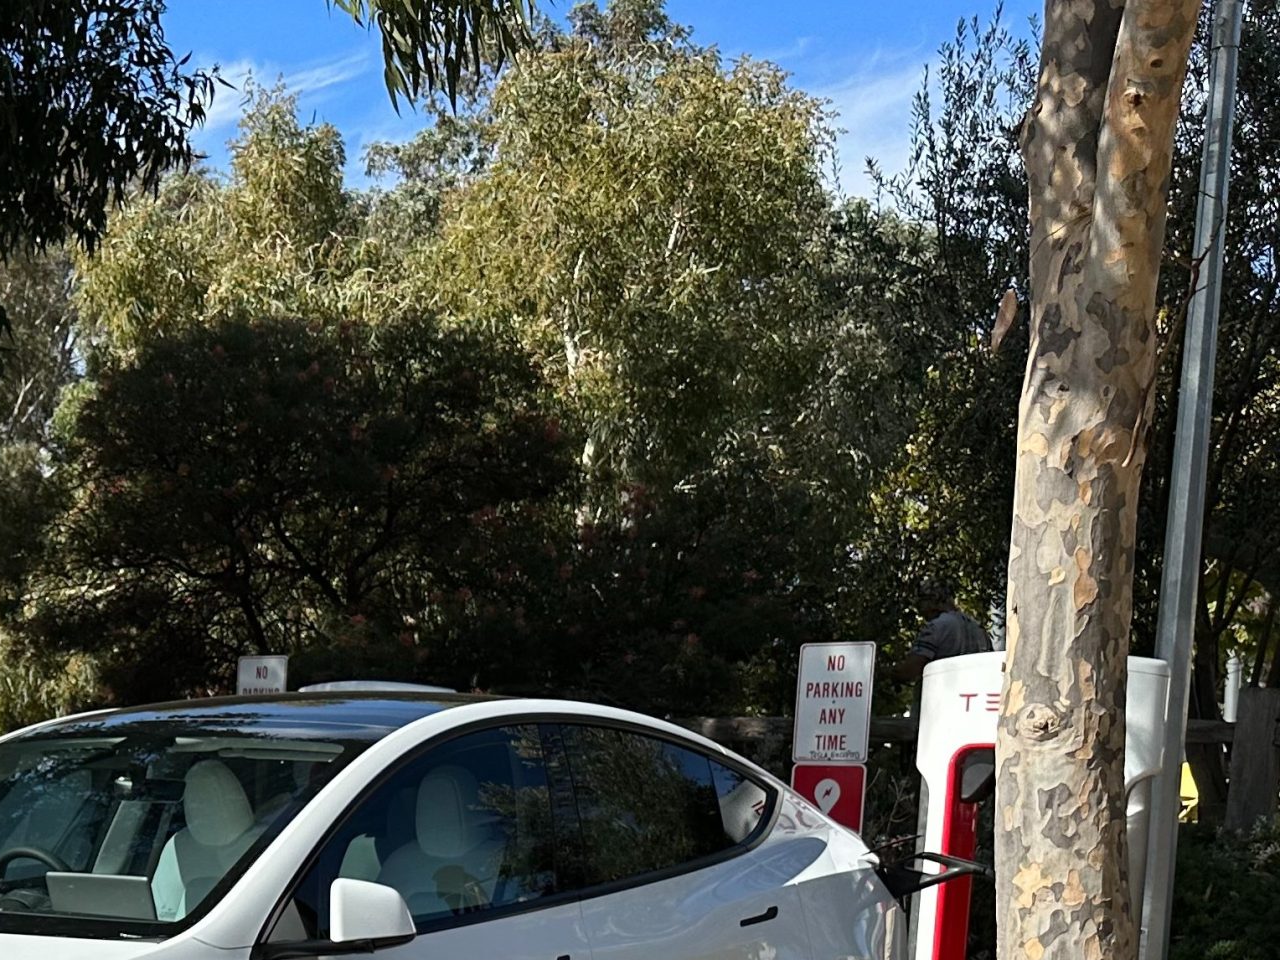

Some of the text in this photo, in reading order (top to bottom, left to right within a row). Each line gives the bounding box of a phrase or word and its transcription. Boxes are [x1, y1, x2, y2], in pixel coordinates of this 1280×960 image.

[827, 655, 845, 672] NO
[256, 665, 268, 680] NO
[806, 681, 863, 698] PARKING
[819, 708, 846, 725] ANY
[815, 734, 847, 751] TIME
